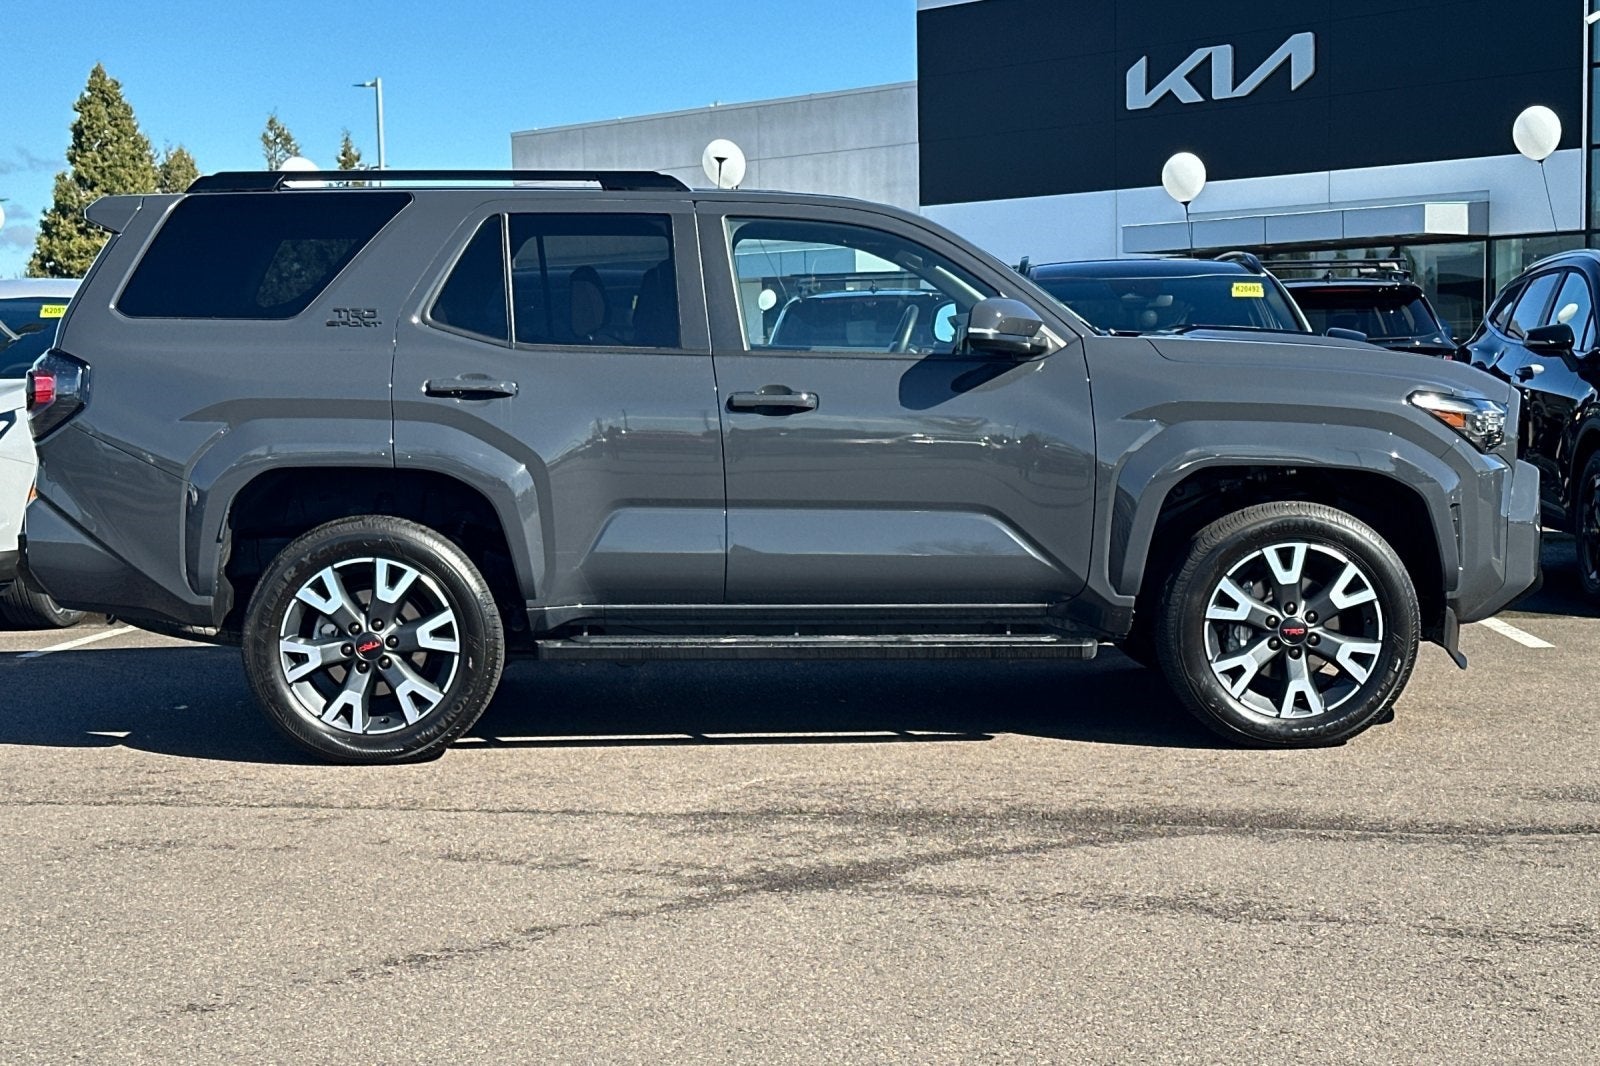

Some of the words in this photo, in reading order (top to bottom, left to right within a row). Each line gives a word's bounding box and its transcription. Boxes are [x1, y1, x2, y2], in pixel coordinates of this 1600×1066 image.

[332, 307, 377, 321] TRD
[326, 320, 382, 328] SPORT
[1283, 627, 1305, 636] TRD
